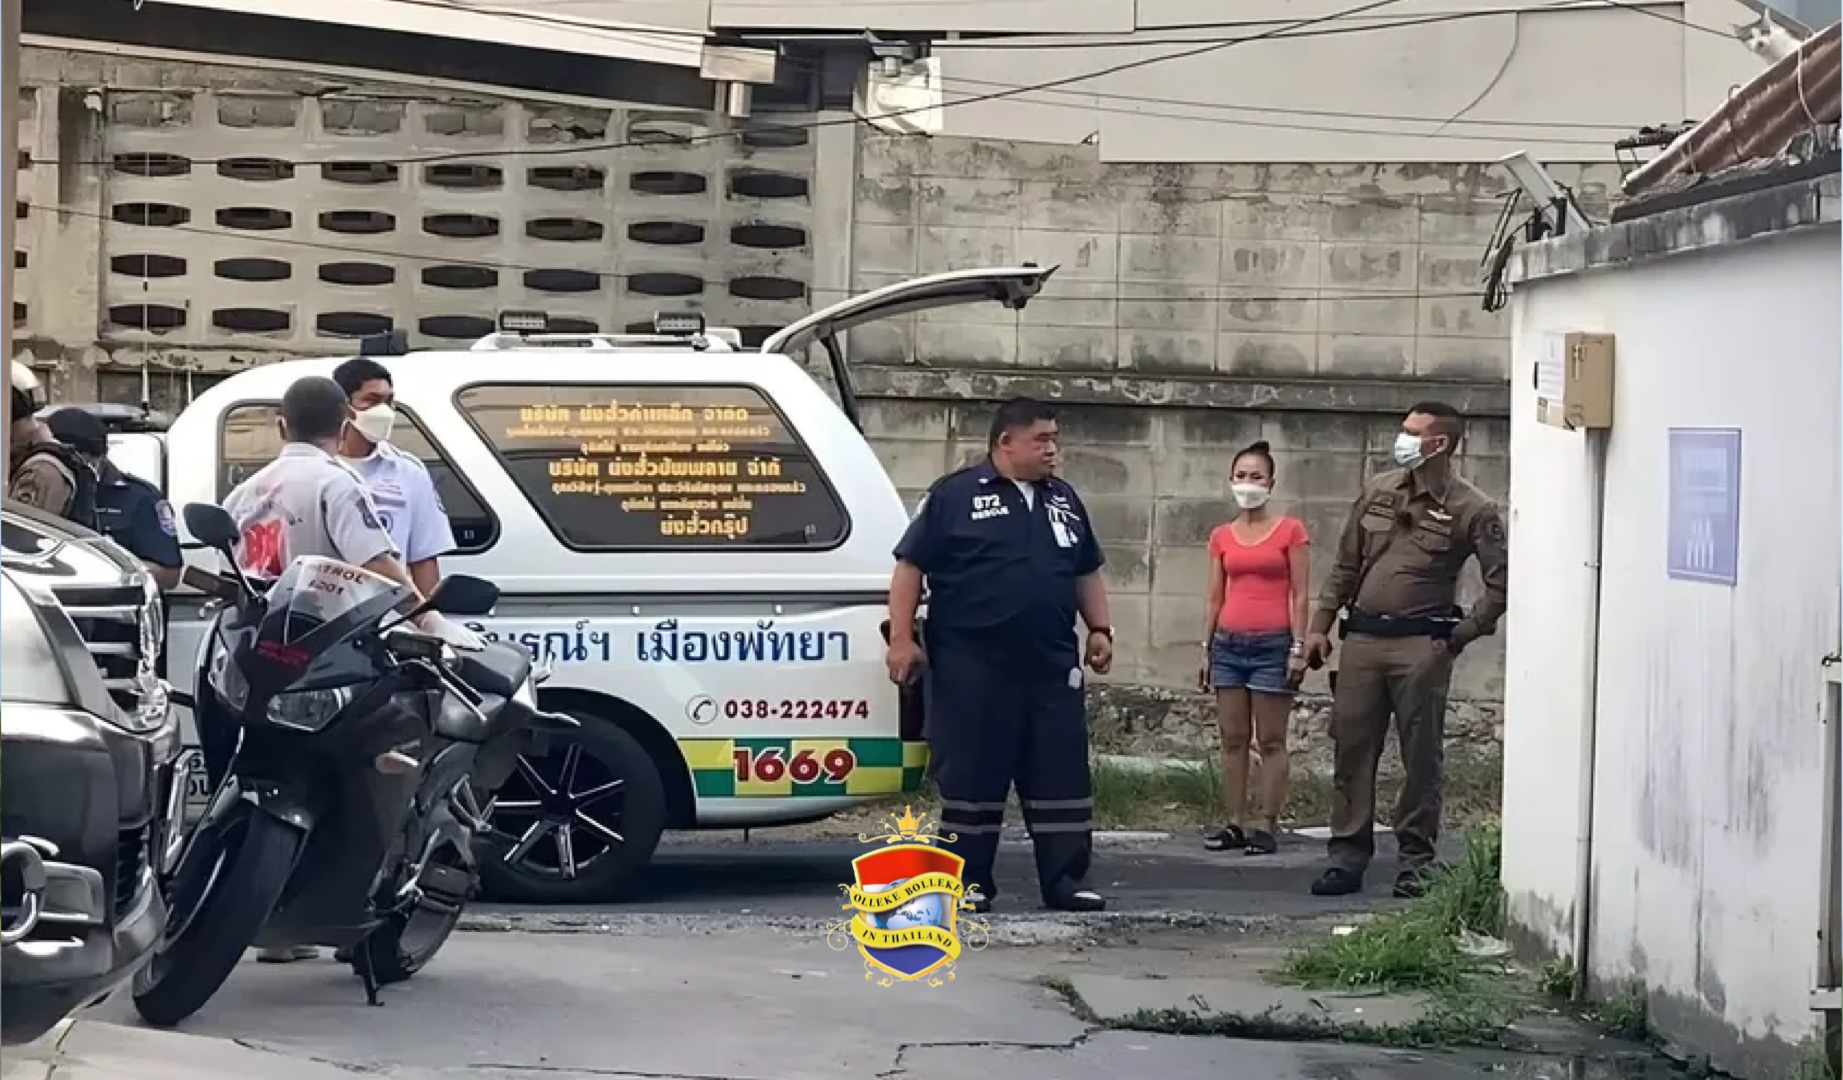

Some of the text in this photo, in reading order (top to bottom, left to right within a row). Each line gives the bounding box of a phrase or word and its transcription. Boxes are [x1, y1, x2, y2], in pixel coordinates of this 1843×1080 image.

[549, 457, 599, 476] บริษัท
[637, 619, 849, 662] เมืองพัทยา
[724, 700, 869, 719] 038-222474
[733, 746, 856, 784] 1669
